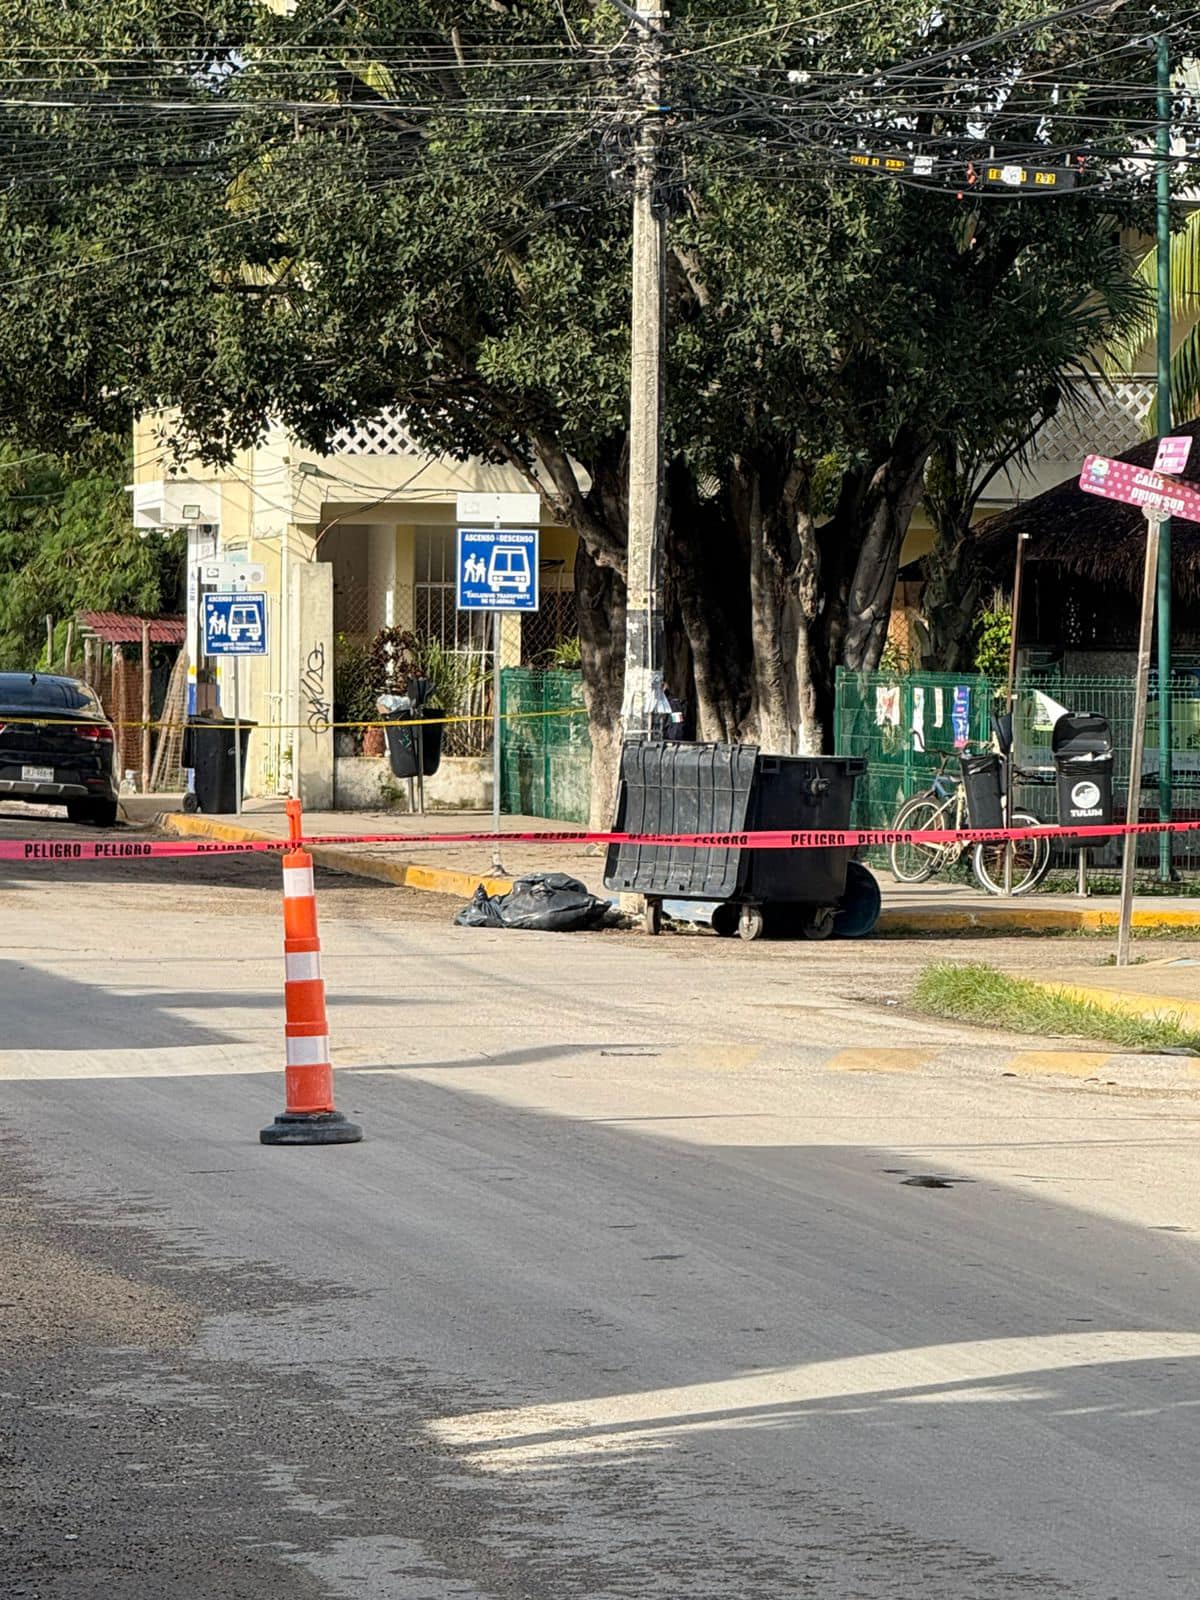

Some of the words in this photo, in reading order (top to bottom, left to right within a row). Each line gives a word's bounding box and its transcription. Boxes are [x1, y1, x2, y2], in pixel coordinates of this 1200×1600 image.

[1134, 473, 1164, 490] CALLE
[1130, 487, 1161, 506] ORION
[1162, 495, 1185, 511] SUR
[464, 534, 495, 543] ASCENSO
[500, 534, 534, 544] DESCENSO
[1070, 808, 1103, 818] TULUM
[25, 844, 81, 858] PELIGRO
[95, 843, 152, 857] PELIGRO
[791, 834, 845, 847] PELIGRO
